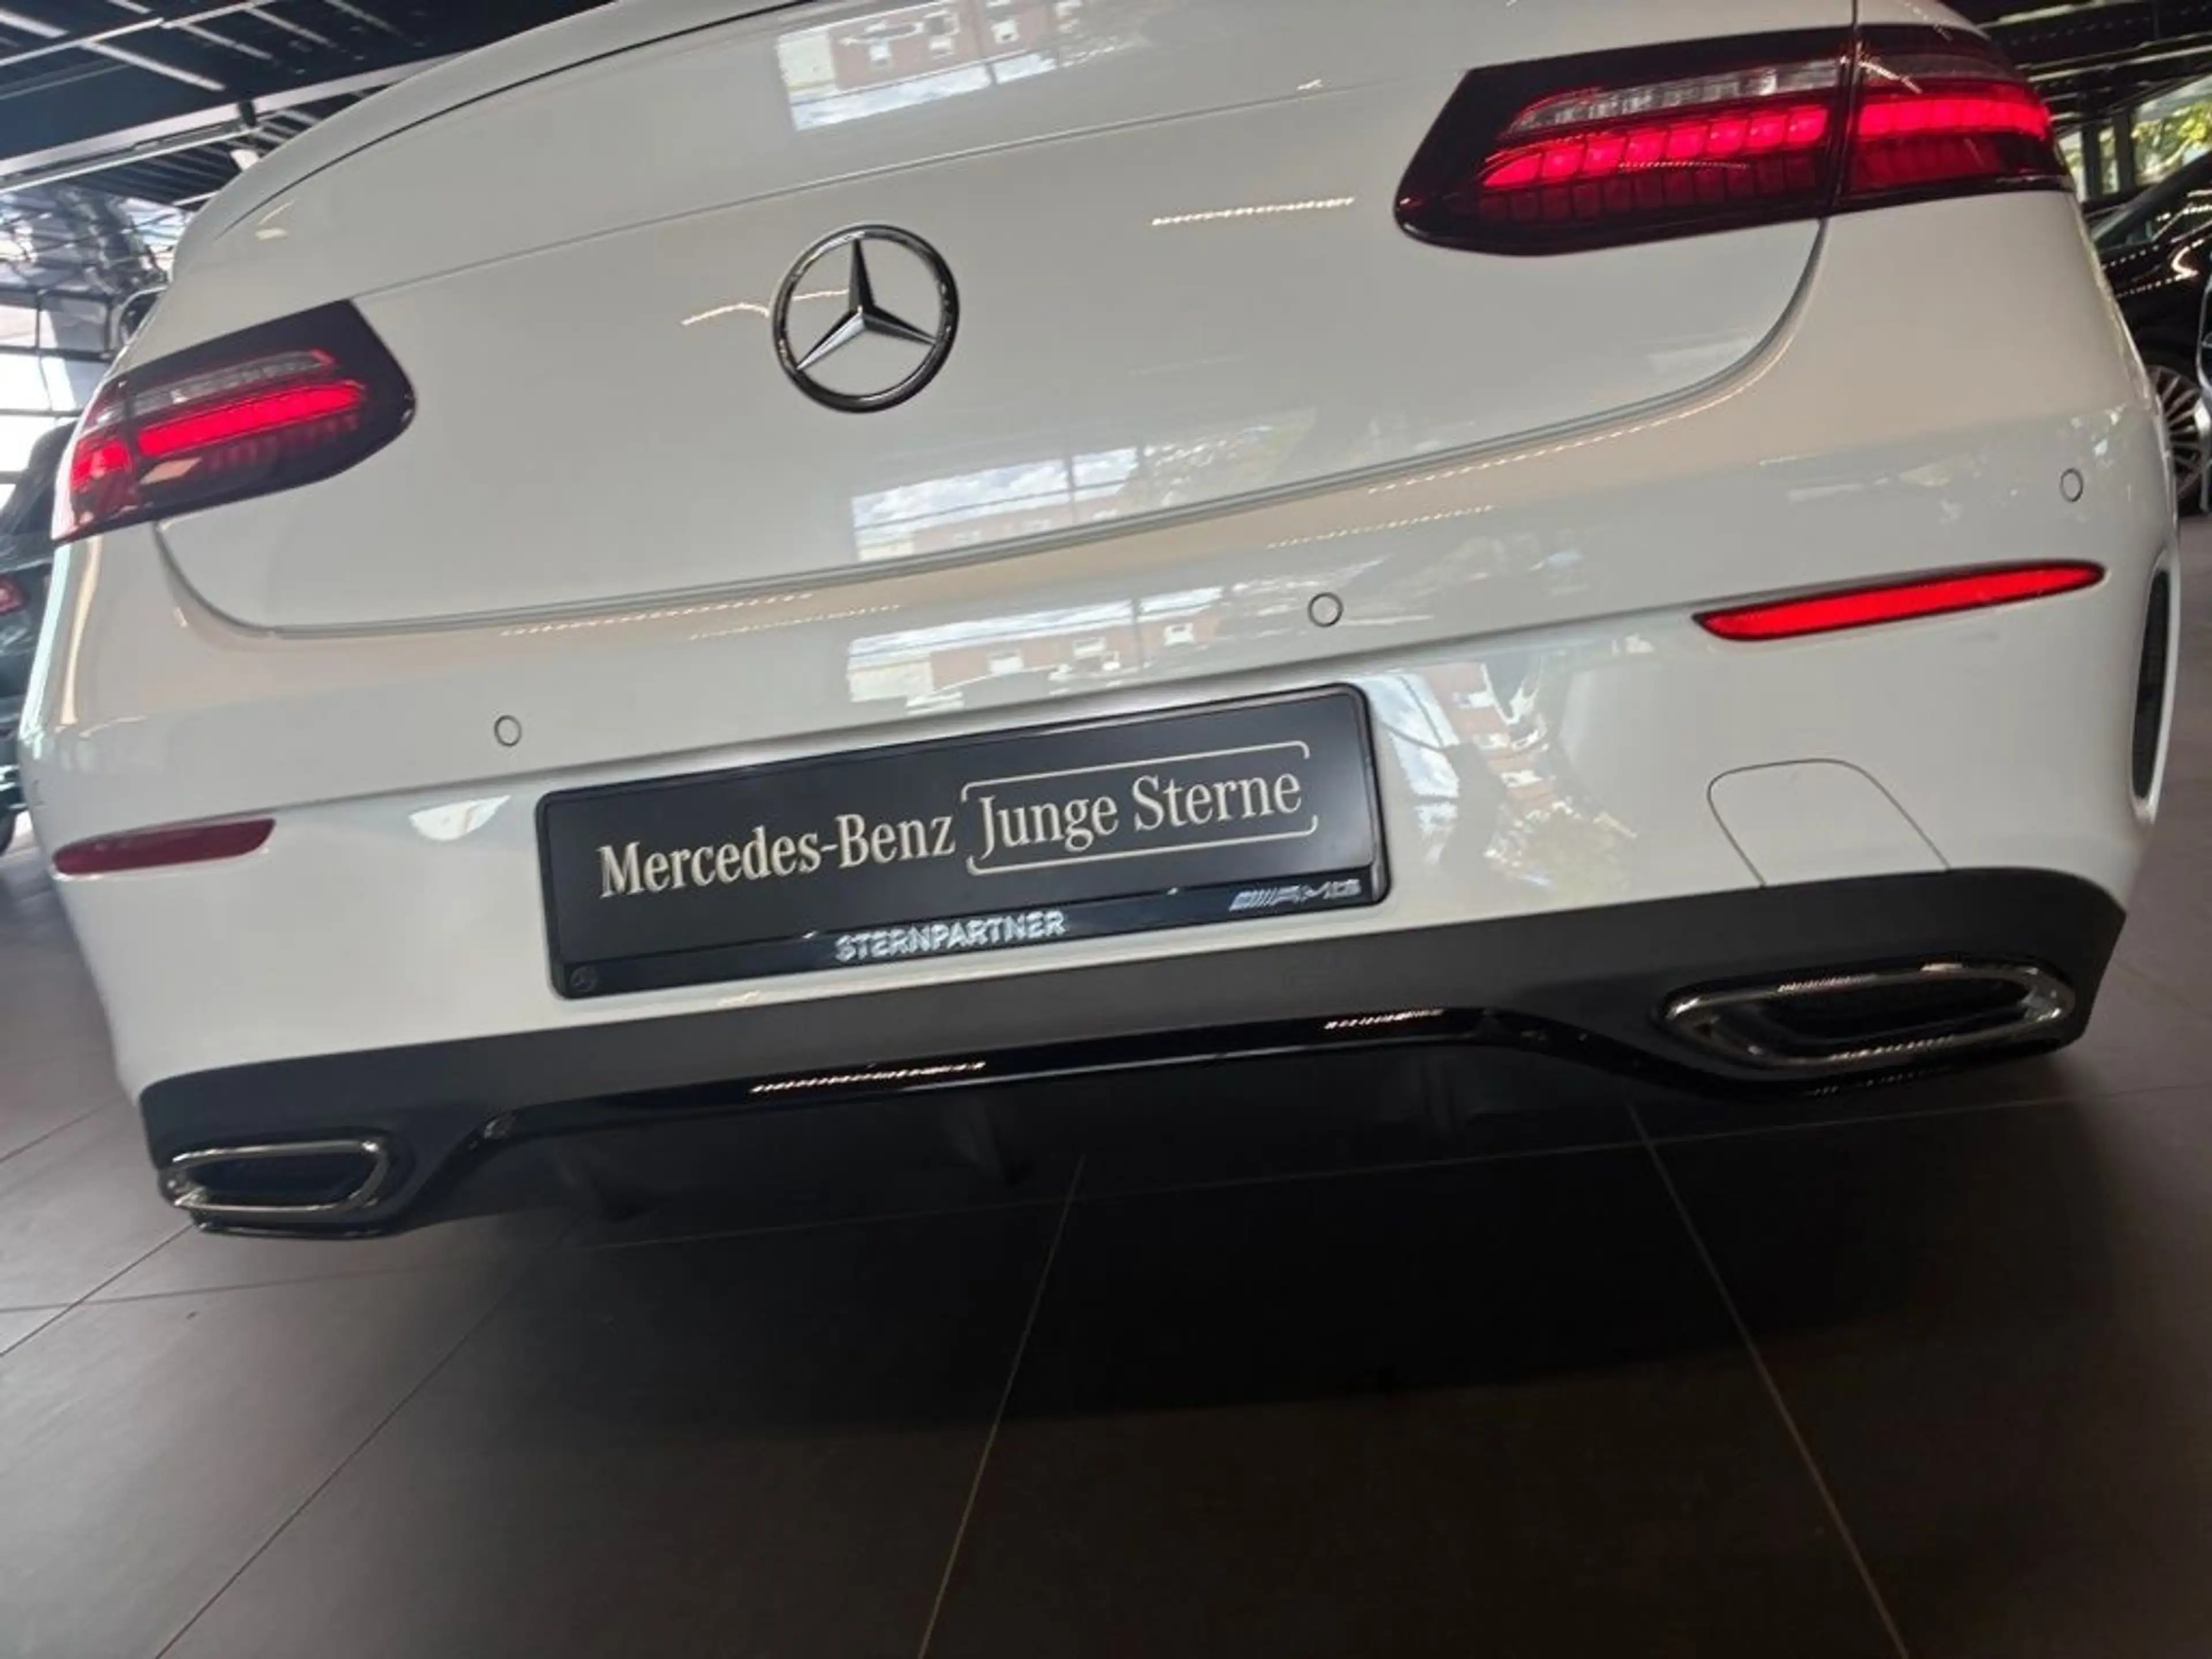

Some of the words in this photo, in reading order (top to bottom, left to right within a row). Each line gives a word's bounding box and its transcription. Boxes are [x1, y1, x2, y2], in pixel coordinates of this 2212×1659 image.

[596, 813, 957, 899] Mercedes-Benz
[978, 794, 1118, 861] Junge
[1131, 772, 1302, 832] Sterne
[834, 909, 1067, 963] STERNPARTNER
